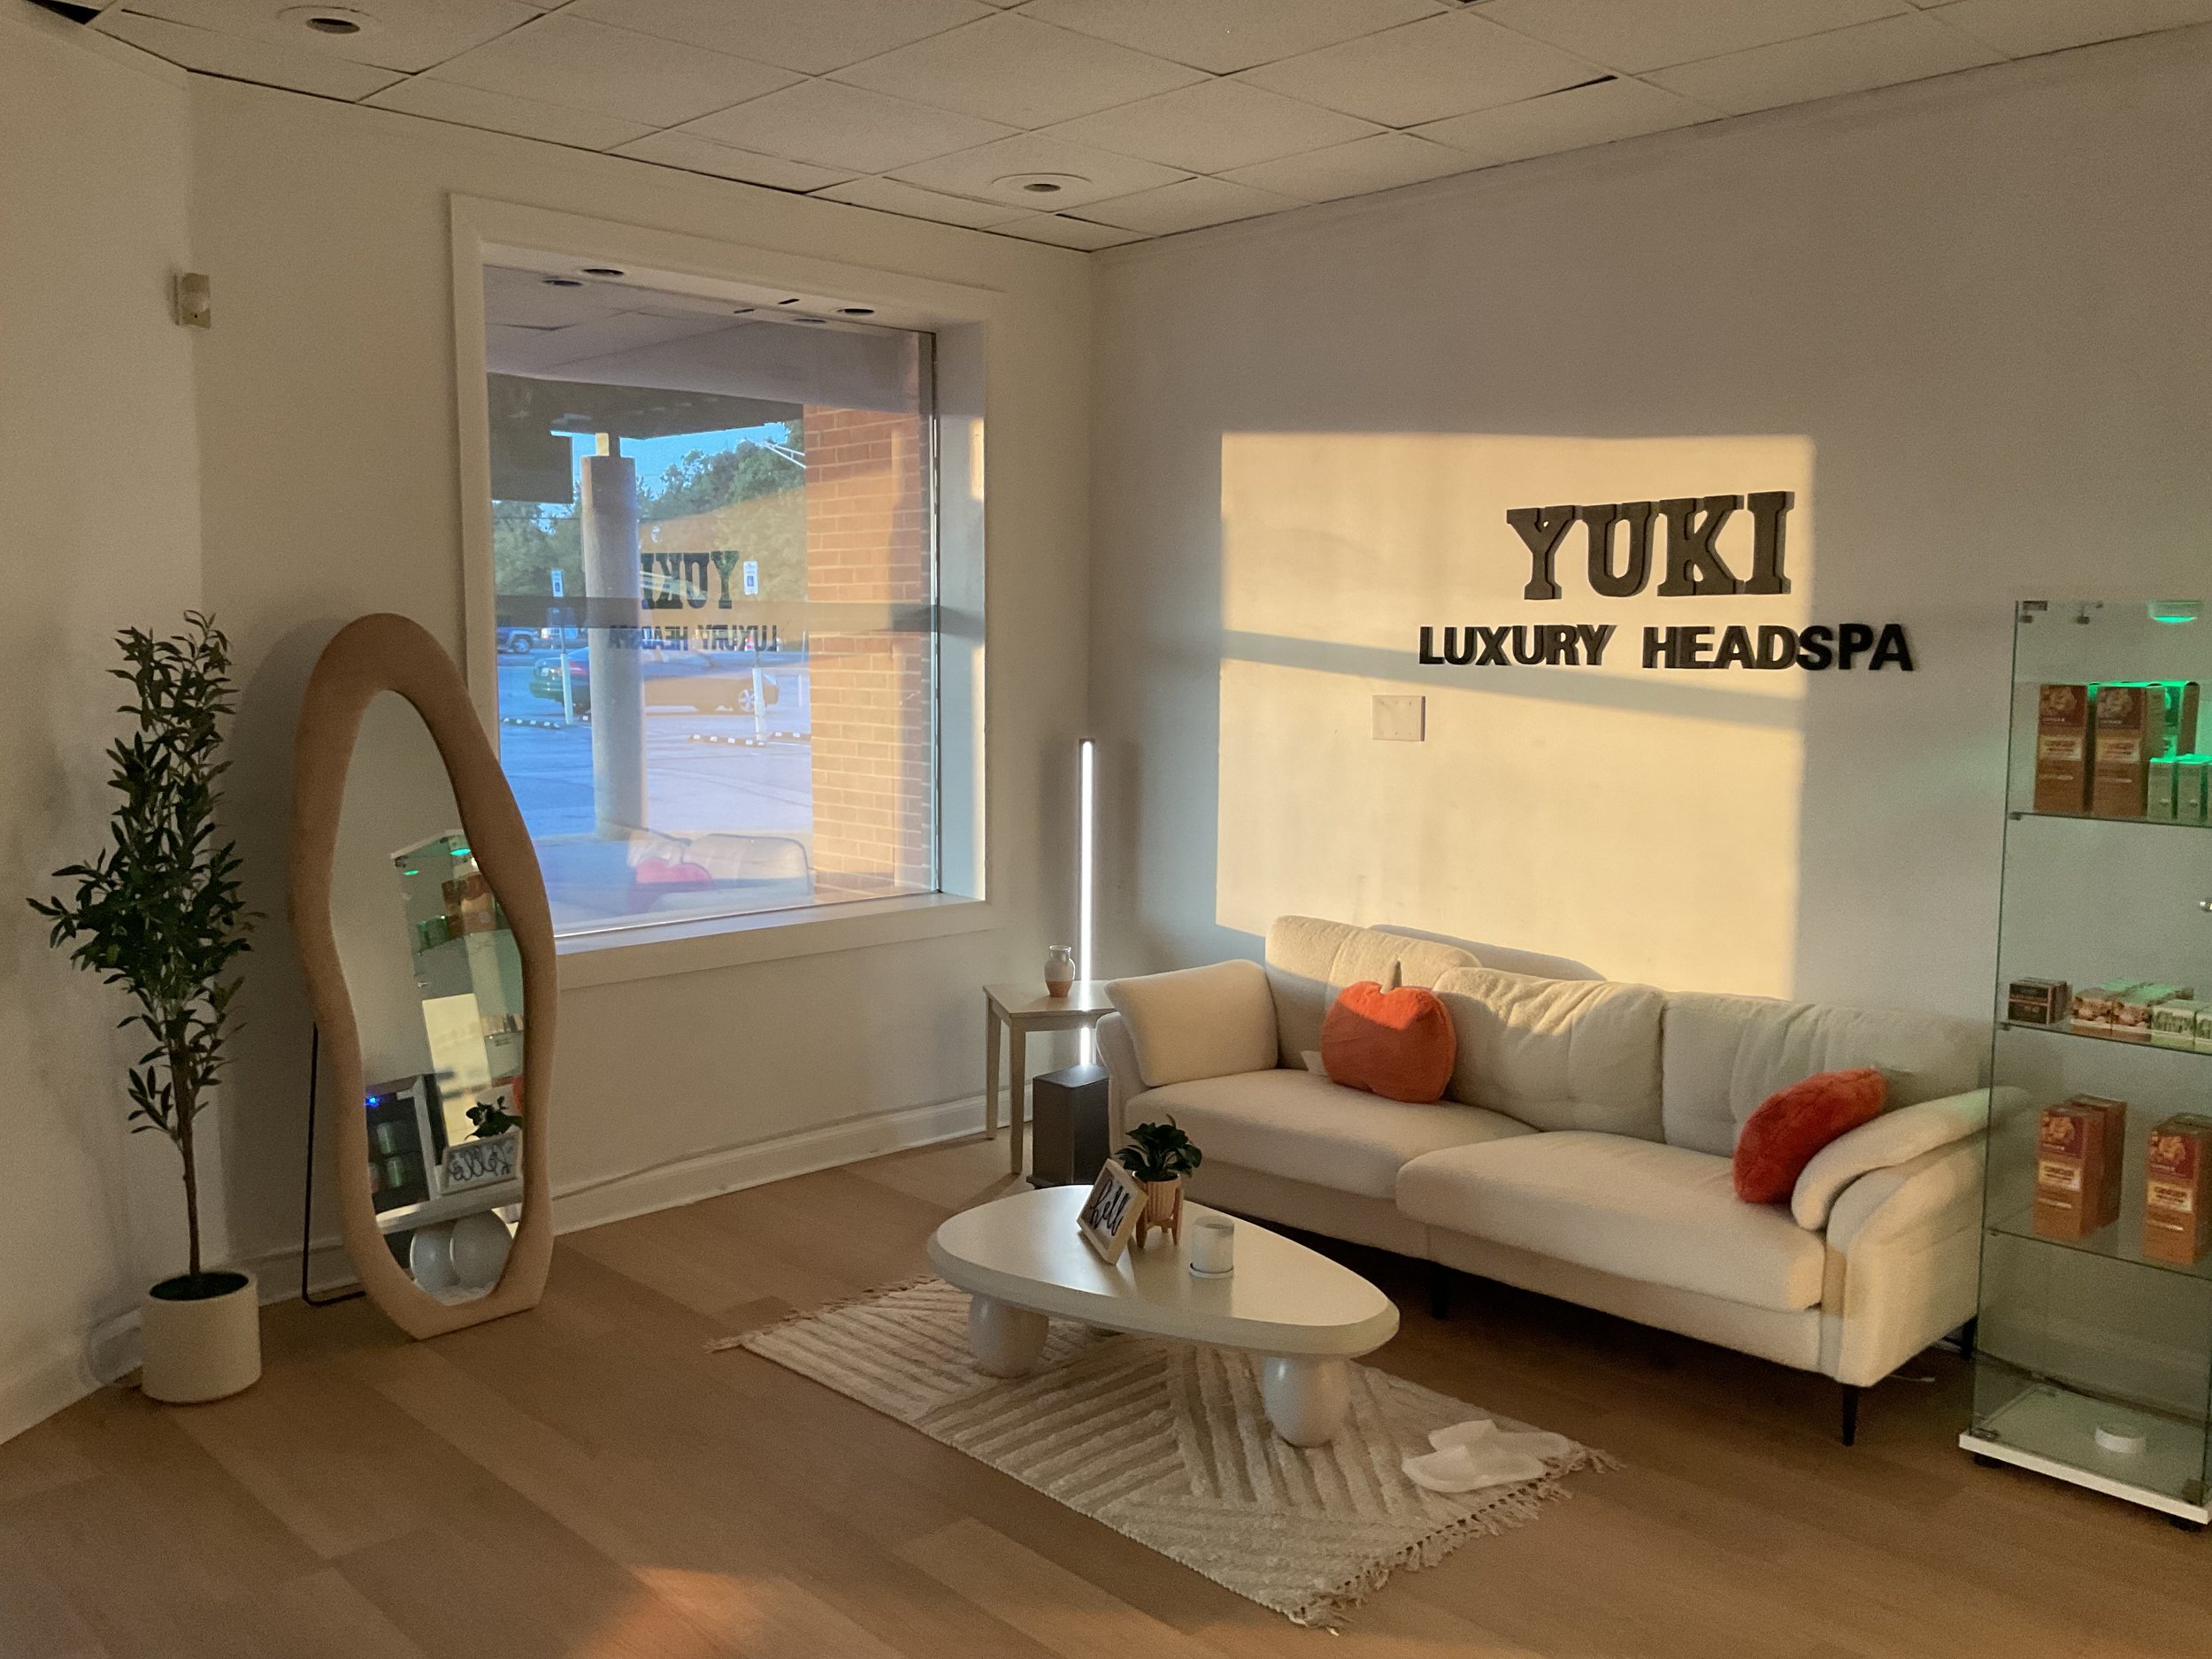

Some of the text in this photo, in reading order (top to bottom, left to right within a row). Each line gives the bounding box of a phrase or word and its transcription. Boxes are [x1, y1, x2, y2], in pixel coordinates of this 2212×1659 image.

[1506, 490, 1795, 600] YUKI
[1419, 623, 1914, 672] LUXURY HEADSPA
[1088, 1179, 1130, 1236] hell
